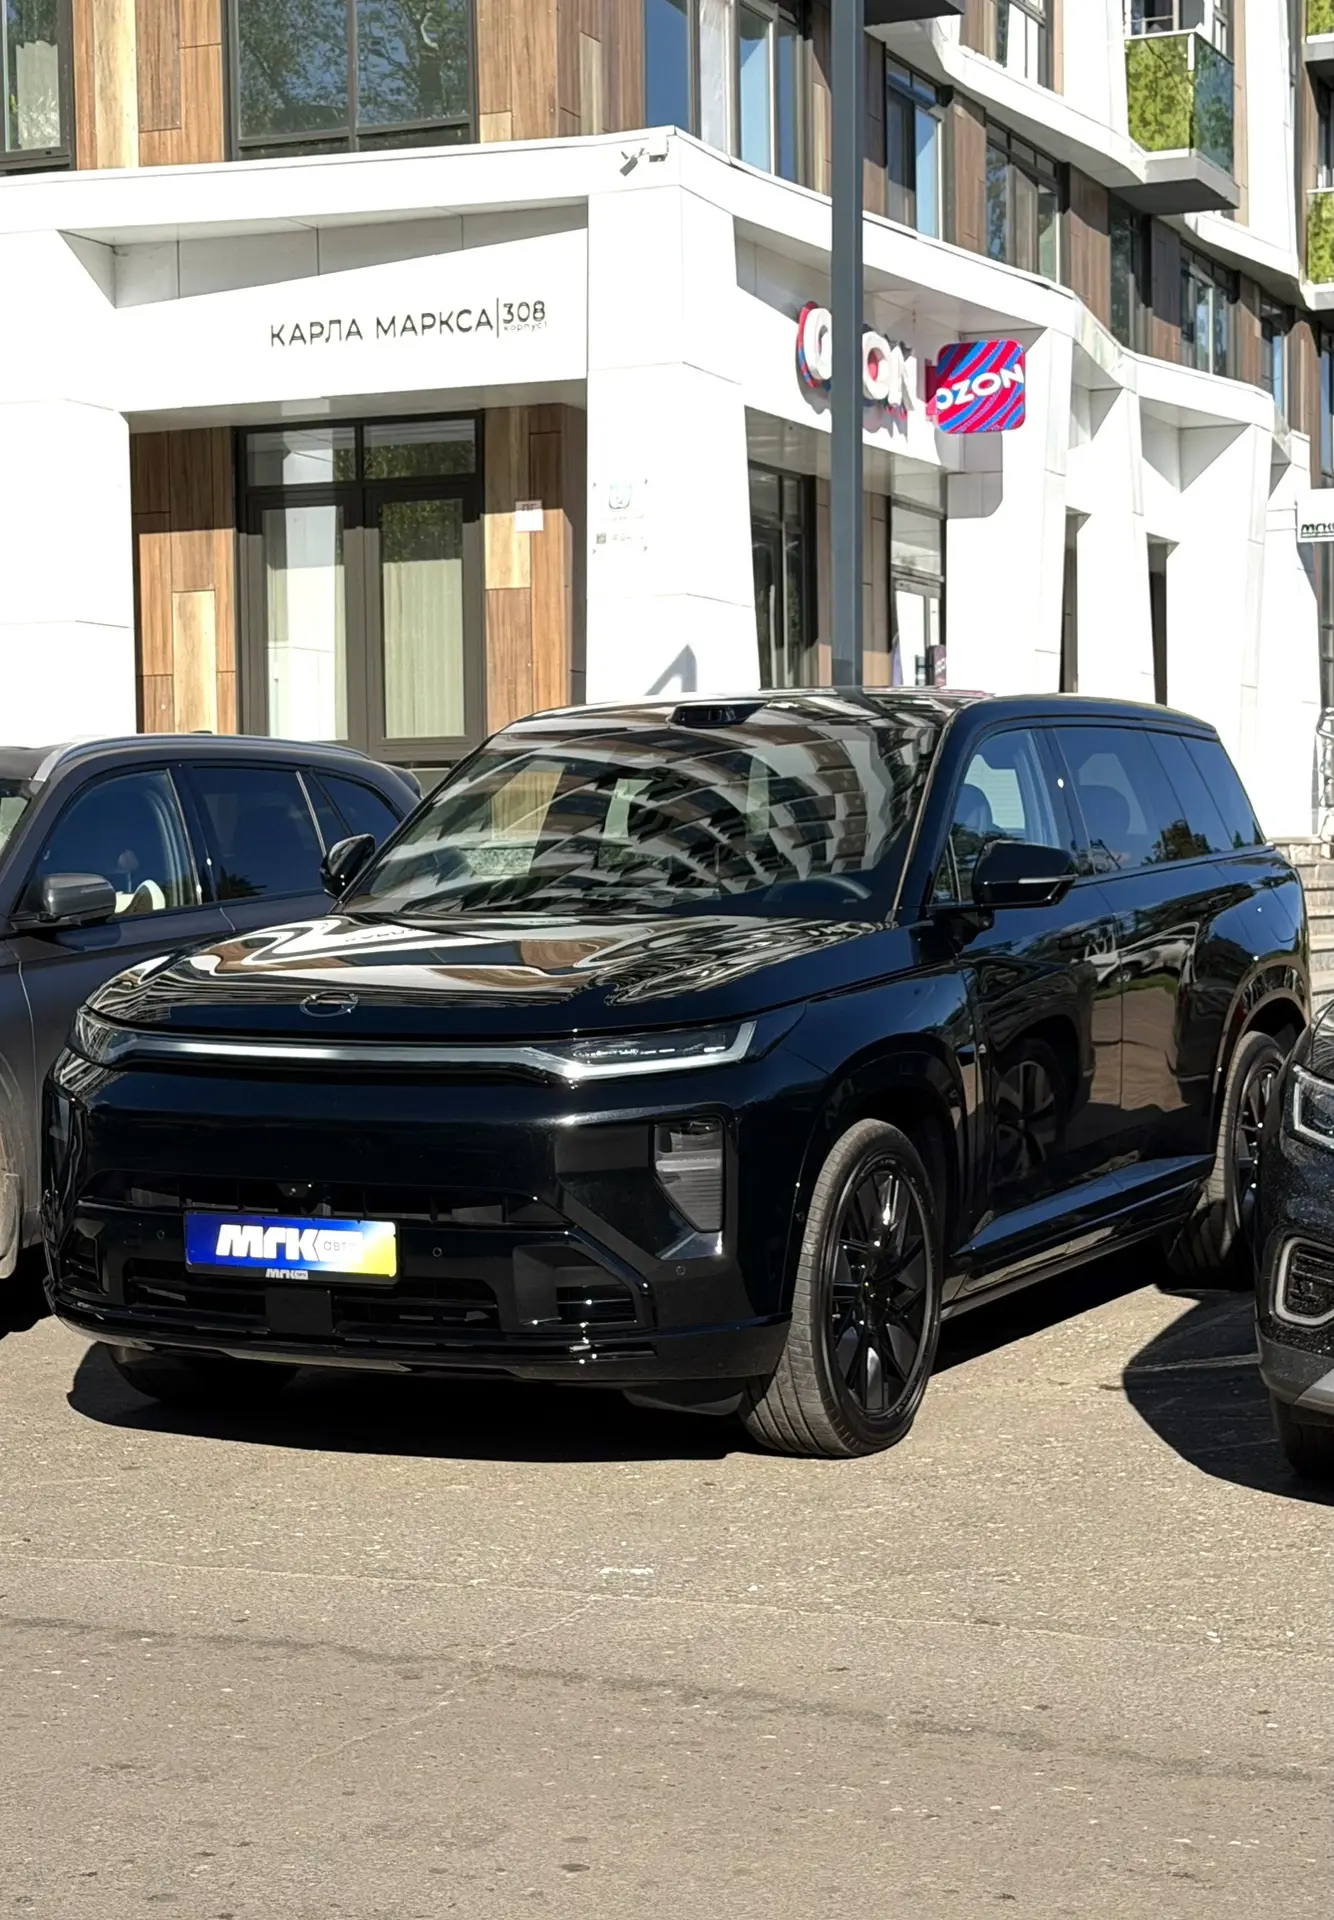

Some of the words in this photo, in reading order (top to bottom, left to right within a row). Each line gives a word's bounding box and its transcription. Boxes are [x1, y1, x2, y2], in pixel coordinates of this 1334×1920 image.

[270, 318, 363, 347] КАРЛА
[376, 308, 494, 340] МАРКСА
[502, 300, 546, 322] 308
[804, 307, 917, 412] OON
[936, 363, 1025, 410] OZON
